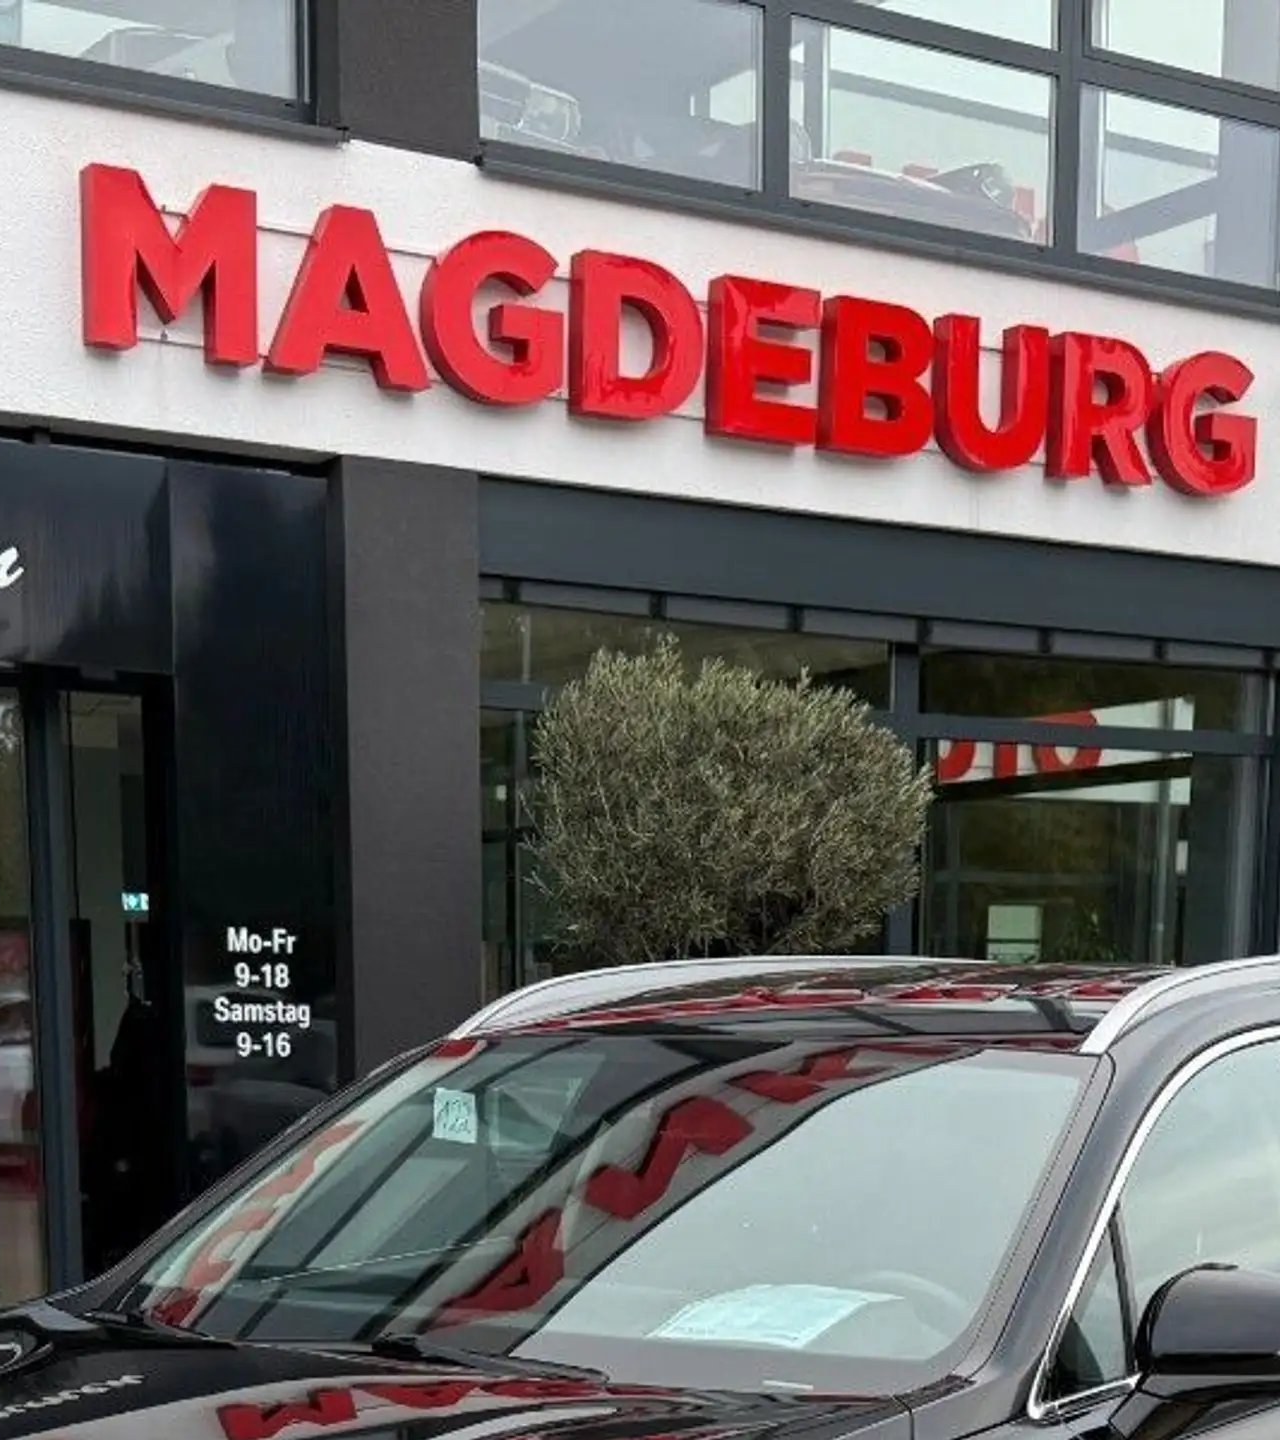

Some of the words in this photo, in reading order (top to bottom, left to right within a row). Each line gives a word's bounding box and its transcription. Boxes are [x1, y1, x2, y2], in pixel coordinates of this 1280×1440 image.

[80, 163, 1257, 497] MAGDEBURG
[227, 927, 296, 954] Mo-Fr
[235, 962, 289, 988] 9-18
[214, 996, 311, 1028] Samstag
[237, 1032, 291, 1057] 9-16
